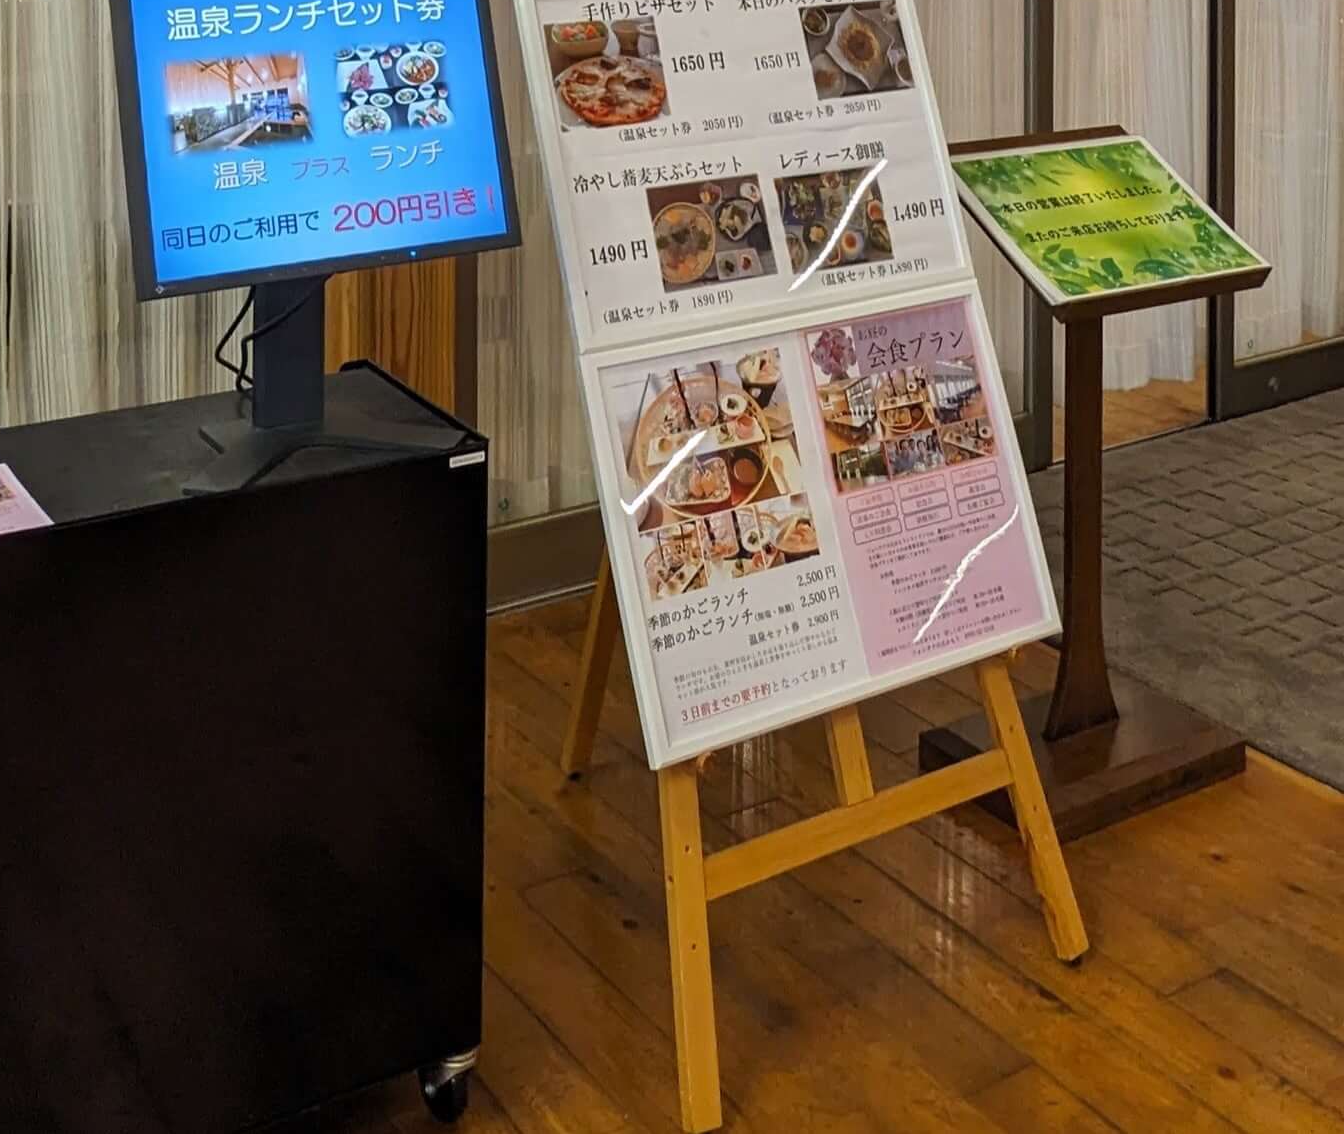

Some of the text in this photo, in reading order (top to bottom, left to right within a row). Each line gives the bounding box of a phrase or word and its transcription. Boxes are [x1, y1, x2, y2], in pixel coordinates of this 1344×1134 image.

[671, 51, 725, 74] 1650円
[754, 51, 801, 72] 1650円
[213, 159, 268, 190] 温泉
[370, 139, 444, 171] ランチ
[573, 156, 744, 194] 冷やし蕎麦天ぷらセット
[161, 186, 497, 251] 同日のご利用で 200円引き！
[893, 198, 945, 222] 1,490円
[590, 239, 649, 266] 1490円
[867, 330, 964, 368] 会食プラン
[648, 588, 749, 631] 季節のかごランチ
[651, 608, 754, 653] 季節のかごランチ
